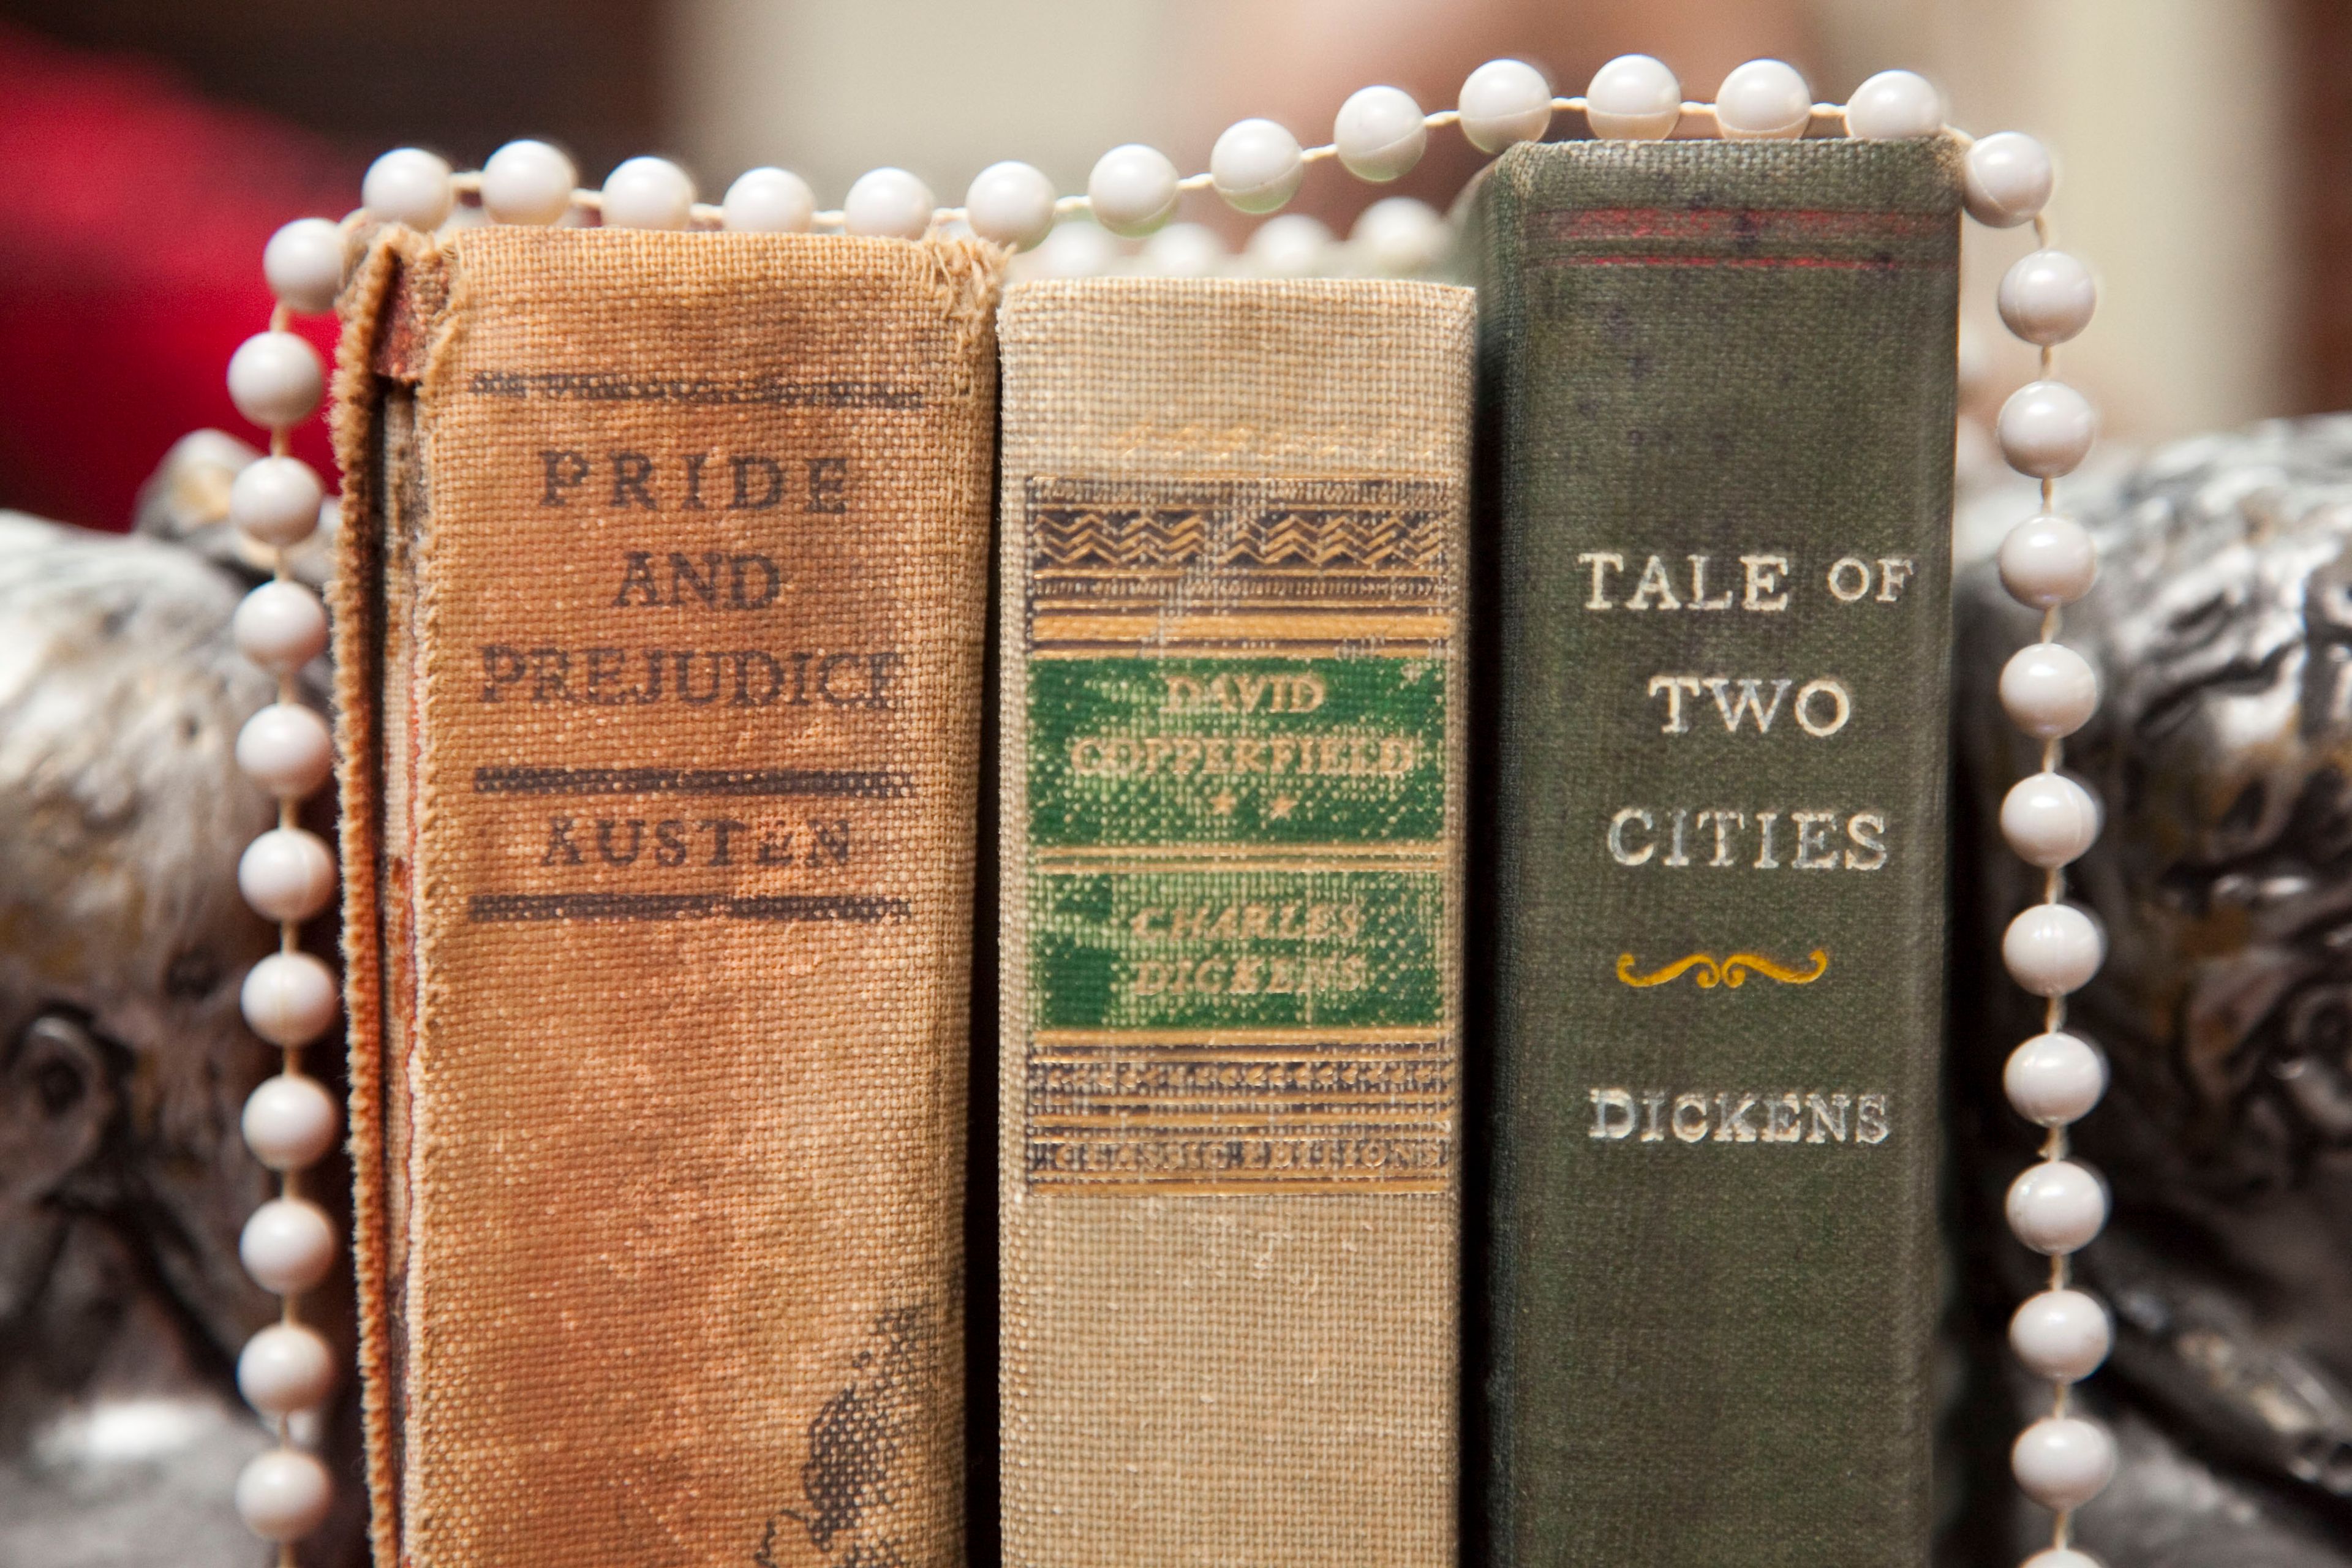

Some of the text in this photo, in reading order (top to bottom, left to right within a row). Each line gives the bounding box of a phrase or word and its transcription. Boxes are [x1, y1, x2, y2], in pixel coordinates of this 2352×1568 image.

[538, 450, 848, 514] PRIDE
[614, 550, 782, 611] AND
[1578, 552, 1913, 611] TALE OF
[479, 644, 903, 710] PREJUDICE
[1161, 674, 1325, 713] DAVID
[1648, 676, 1850, 736] TWO
[1071, 737, 1414, 775] COPPERFIELD
[541, 816, 850, 867] AUSTEN
[1607, 808, 1887, 870] CITIES
[1131, 903, 1361, 941] CHARLES
[1133, 957, 1365, 995] DICKENS
[1589, 1088, 1890, 1144] DICKENS
